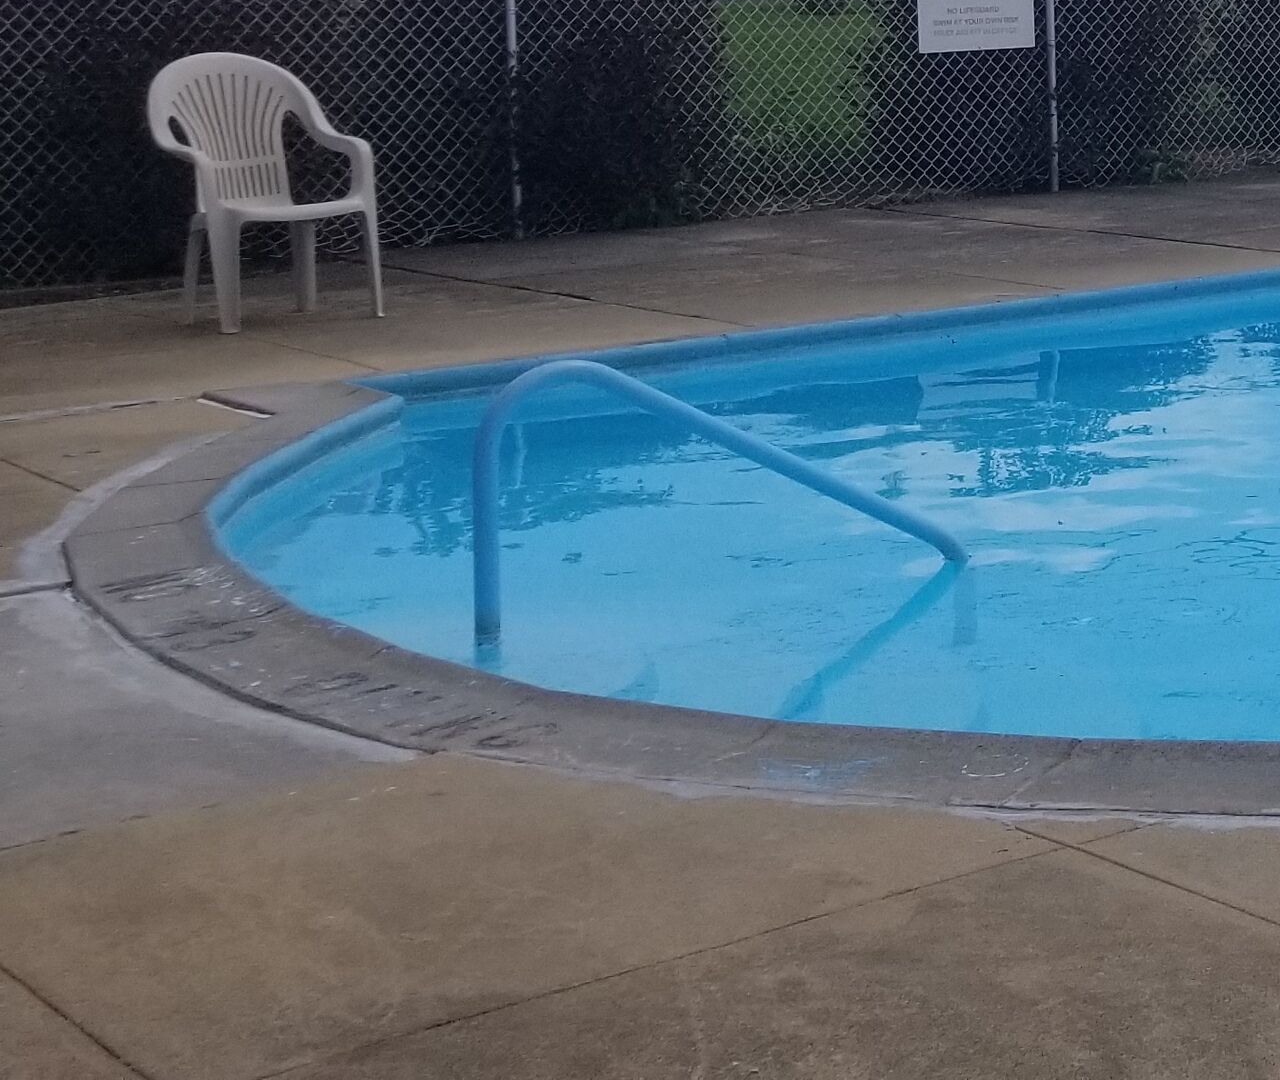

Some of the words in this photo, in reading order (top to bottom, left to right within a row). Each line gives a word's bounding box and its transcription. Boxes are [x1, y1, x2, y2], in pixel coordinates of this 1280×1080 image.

[946, 7, 958, 15] NO
[959, 6, 1000, 14] LIFEGUARD
[933, 19, 952, 27] SWIM
